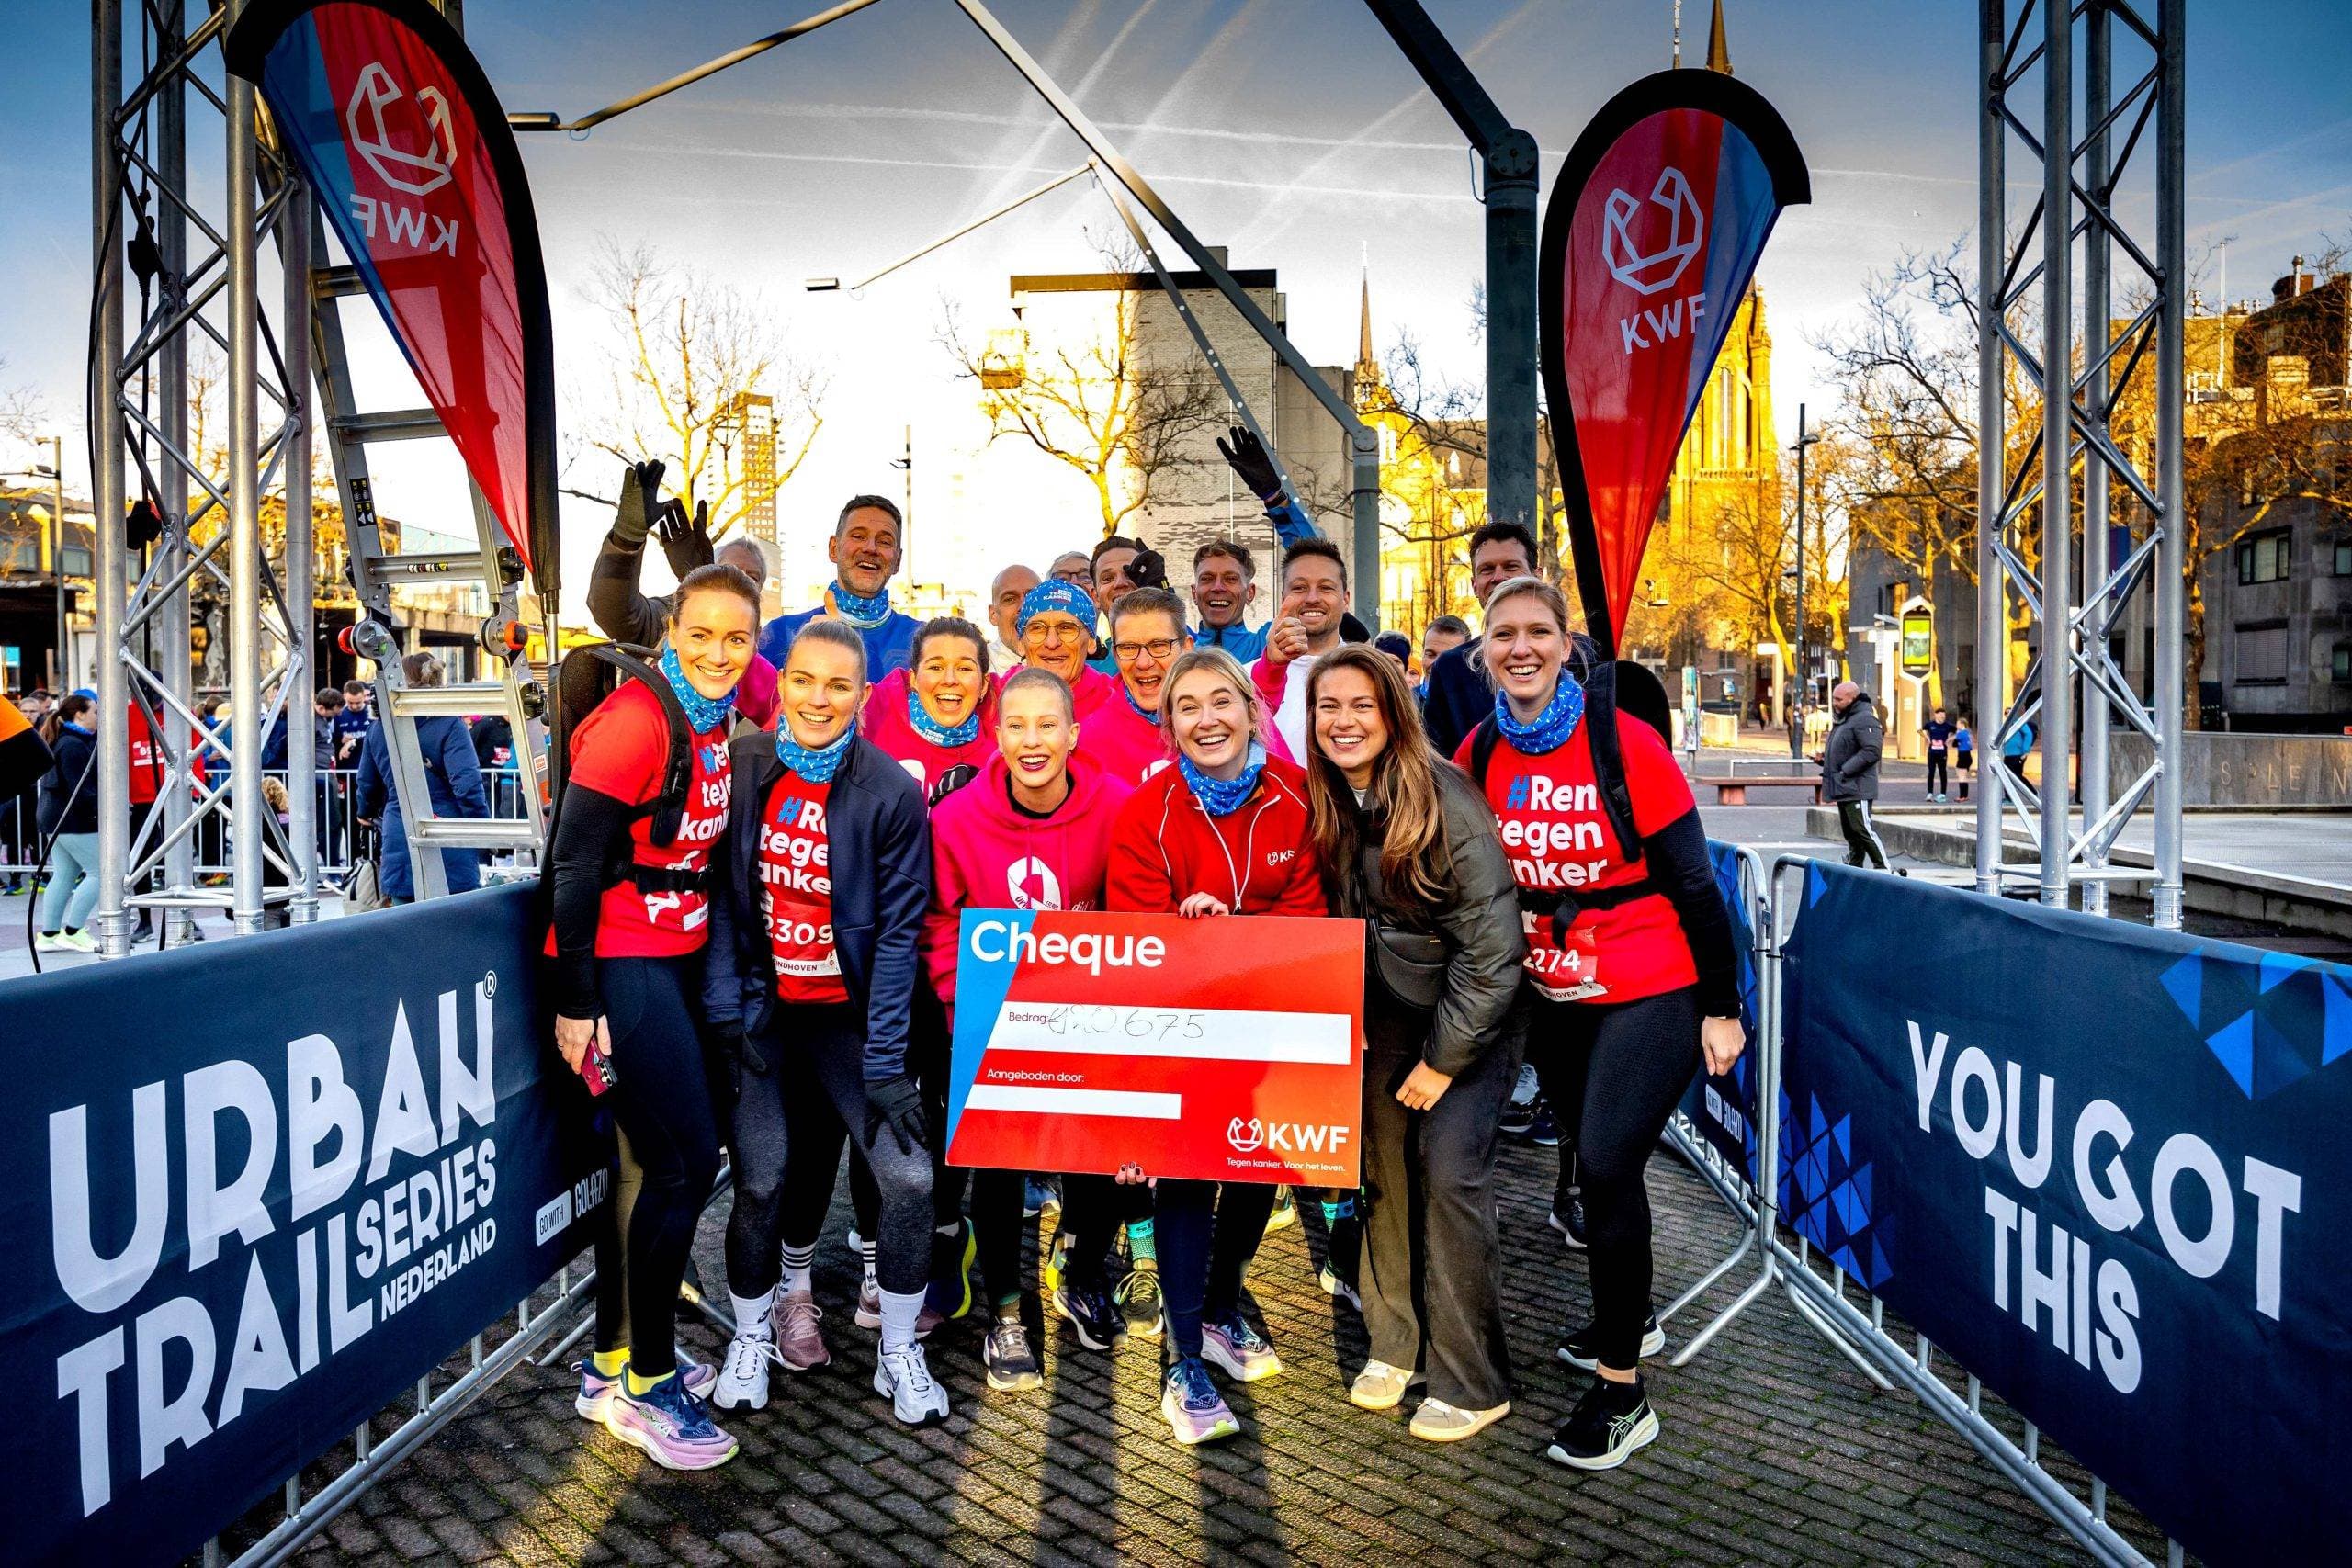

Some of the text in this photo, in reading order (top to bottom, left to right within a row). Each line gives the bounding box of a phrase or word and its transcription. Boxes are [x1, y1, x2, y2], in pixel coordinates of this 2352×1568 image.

[1620, 293, 1706, 354] KWF
[1507, 775, 1598, 812] #Ren
[1280, 850, 1295, 863] KF
[1507, 858, 1608, 886] nker
[970, 920, 1166, 976] Cheque
[1009, 1011, 1050, 1024] Bedrag:
[987, 1068, 1085, 1082] Aangeboden door:
[1268, 1122, 1350, 1154] KWF
[1227, 1157, 1346, 1172] Tegen kanker. Voor het leven.
[1906, 1019, 2302, 1322] YOU GOT
[356, 1139, 496, 1278] SERIES
[539, 1203, 564, 1235] GO WITH
[381, 1218, 497, 1322] NEDERLAND
[1984, 1185, 2143, 1394] THIS
[57, 1213, 373, 1518] TRAIL
